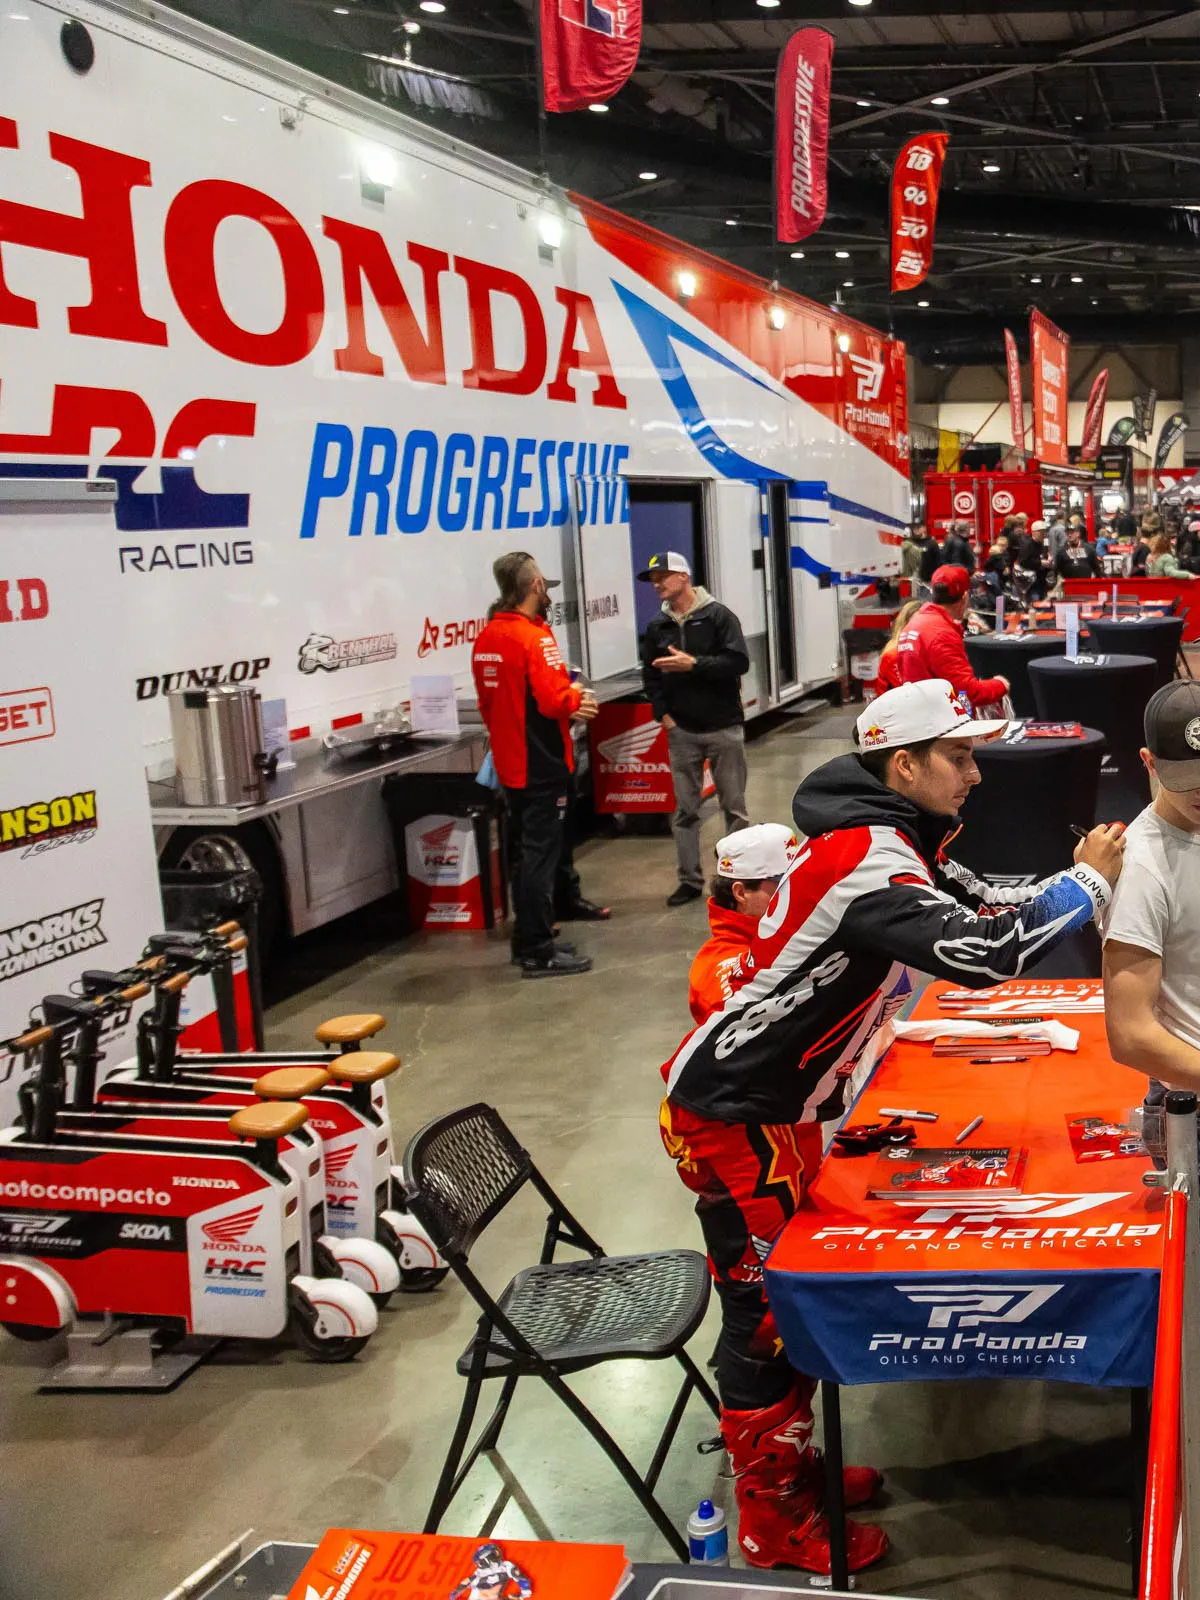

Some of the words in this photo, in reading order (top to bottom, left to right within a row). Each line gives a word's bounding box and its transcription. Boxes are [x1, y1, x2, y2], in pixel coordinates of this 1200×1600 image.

[791, 55, 816, 218] PROGRESSIVE
[906, 152, 933, 171] 18
[903, 186, 928, 206] 96
[896, 221, 929, 239] 30
[0, 116, 628, 410] HONDA
[300, 422, 631, 539] PROGRESSIVE
[119, 541, 254, 574] RACING
[136, 657, 271, 701] DUNLOP
[1075, 871, 1106, 909] SANTO
[172, 1176, 240, 1191] HONDA
[119, 1222, 173, 1241] SKDA
[811, 1226, 931, 1240] Pro
[944, 1222, 1163, 1240] Honda
[202, 1242, 266, 1254] HONDA
[823, 1242, 885, 1251] OILS
[905, 1241, 962, 1251] AND
[981, 1238, 1143, 1250] CHEMICALS
[204, 1257, 266, 1277] HRC
[869, 1333, 944, 1351] Pro
[952, 1332, 1089, 1351] Honda
[880, 1354, 919, 1366] OILS
[931, 1354, 966, 1364] AND
[977, 1352, 1078, 1365] CHEMICALS
